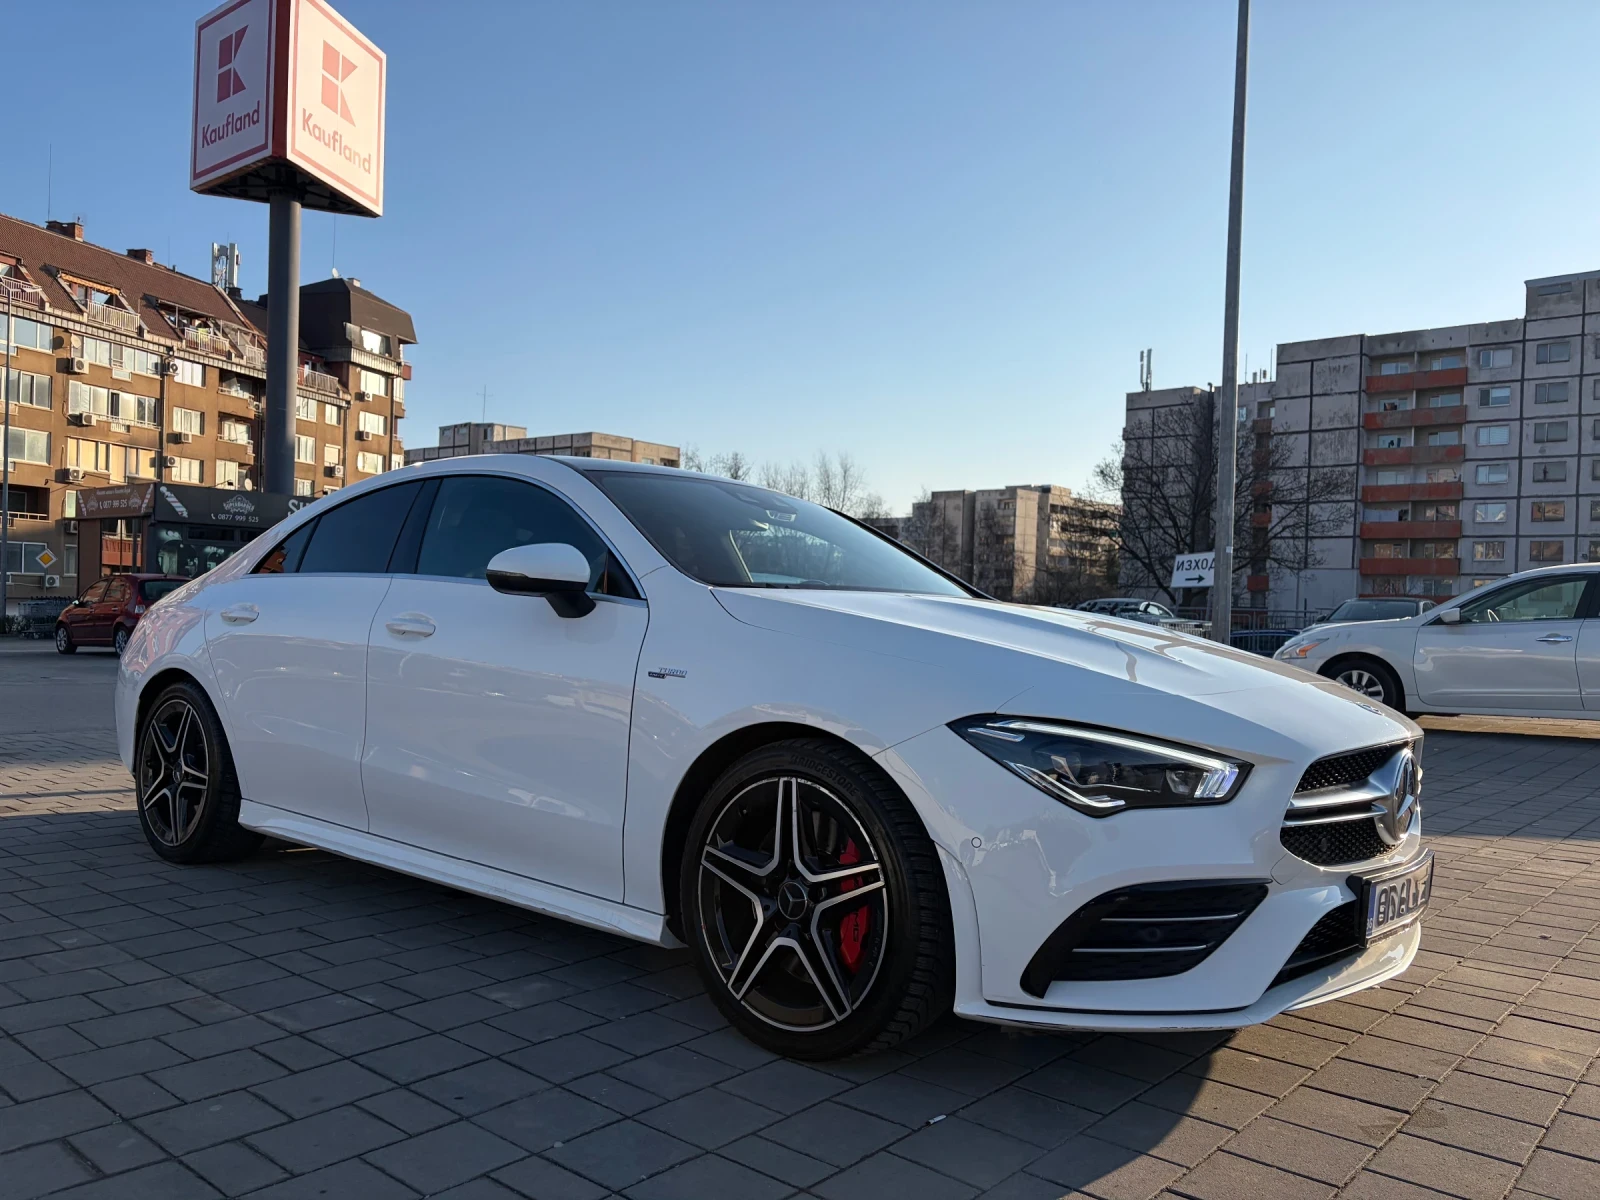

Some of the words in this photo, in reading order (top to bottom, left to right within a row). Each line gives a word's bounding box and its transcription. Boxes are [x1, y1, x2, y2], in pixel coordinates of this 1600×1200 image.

[201, 100, 261, 149] Kaufland
[302, 107, 372, 175] Kaufland
[217, 513, 233, 521] 0877
[788, 753, 860, 797] BRIDGESTONE
